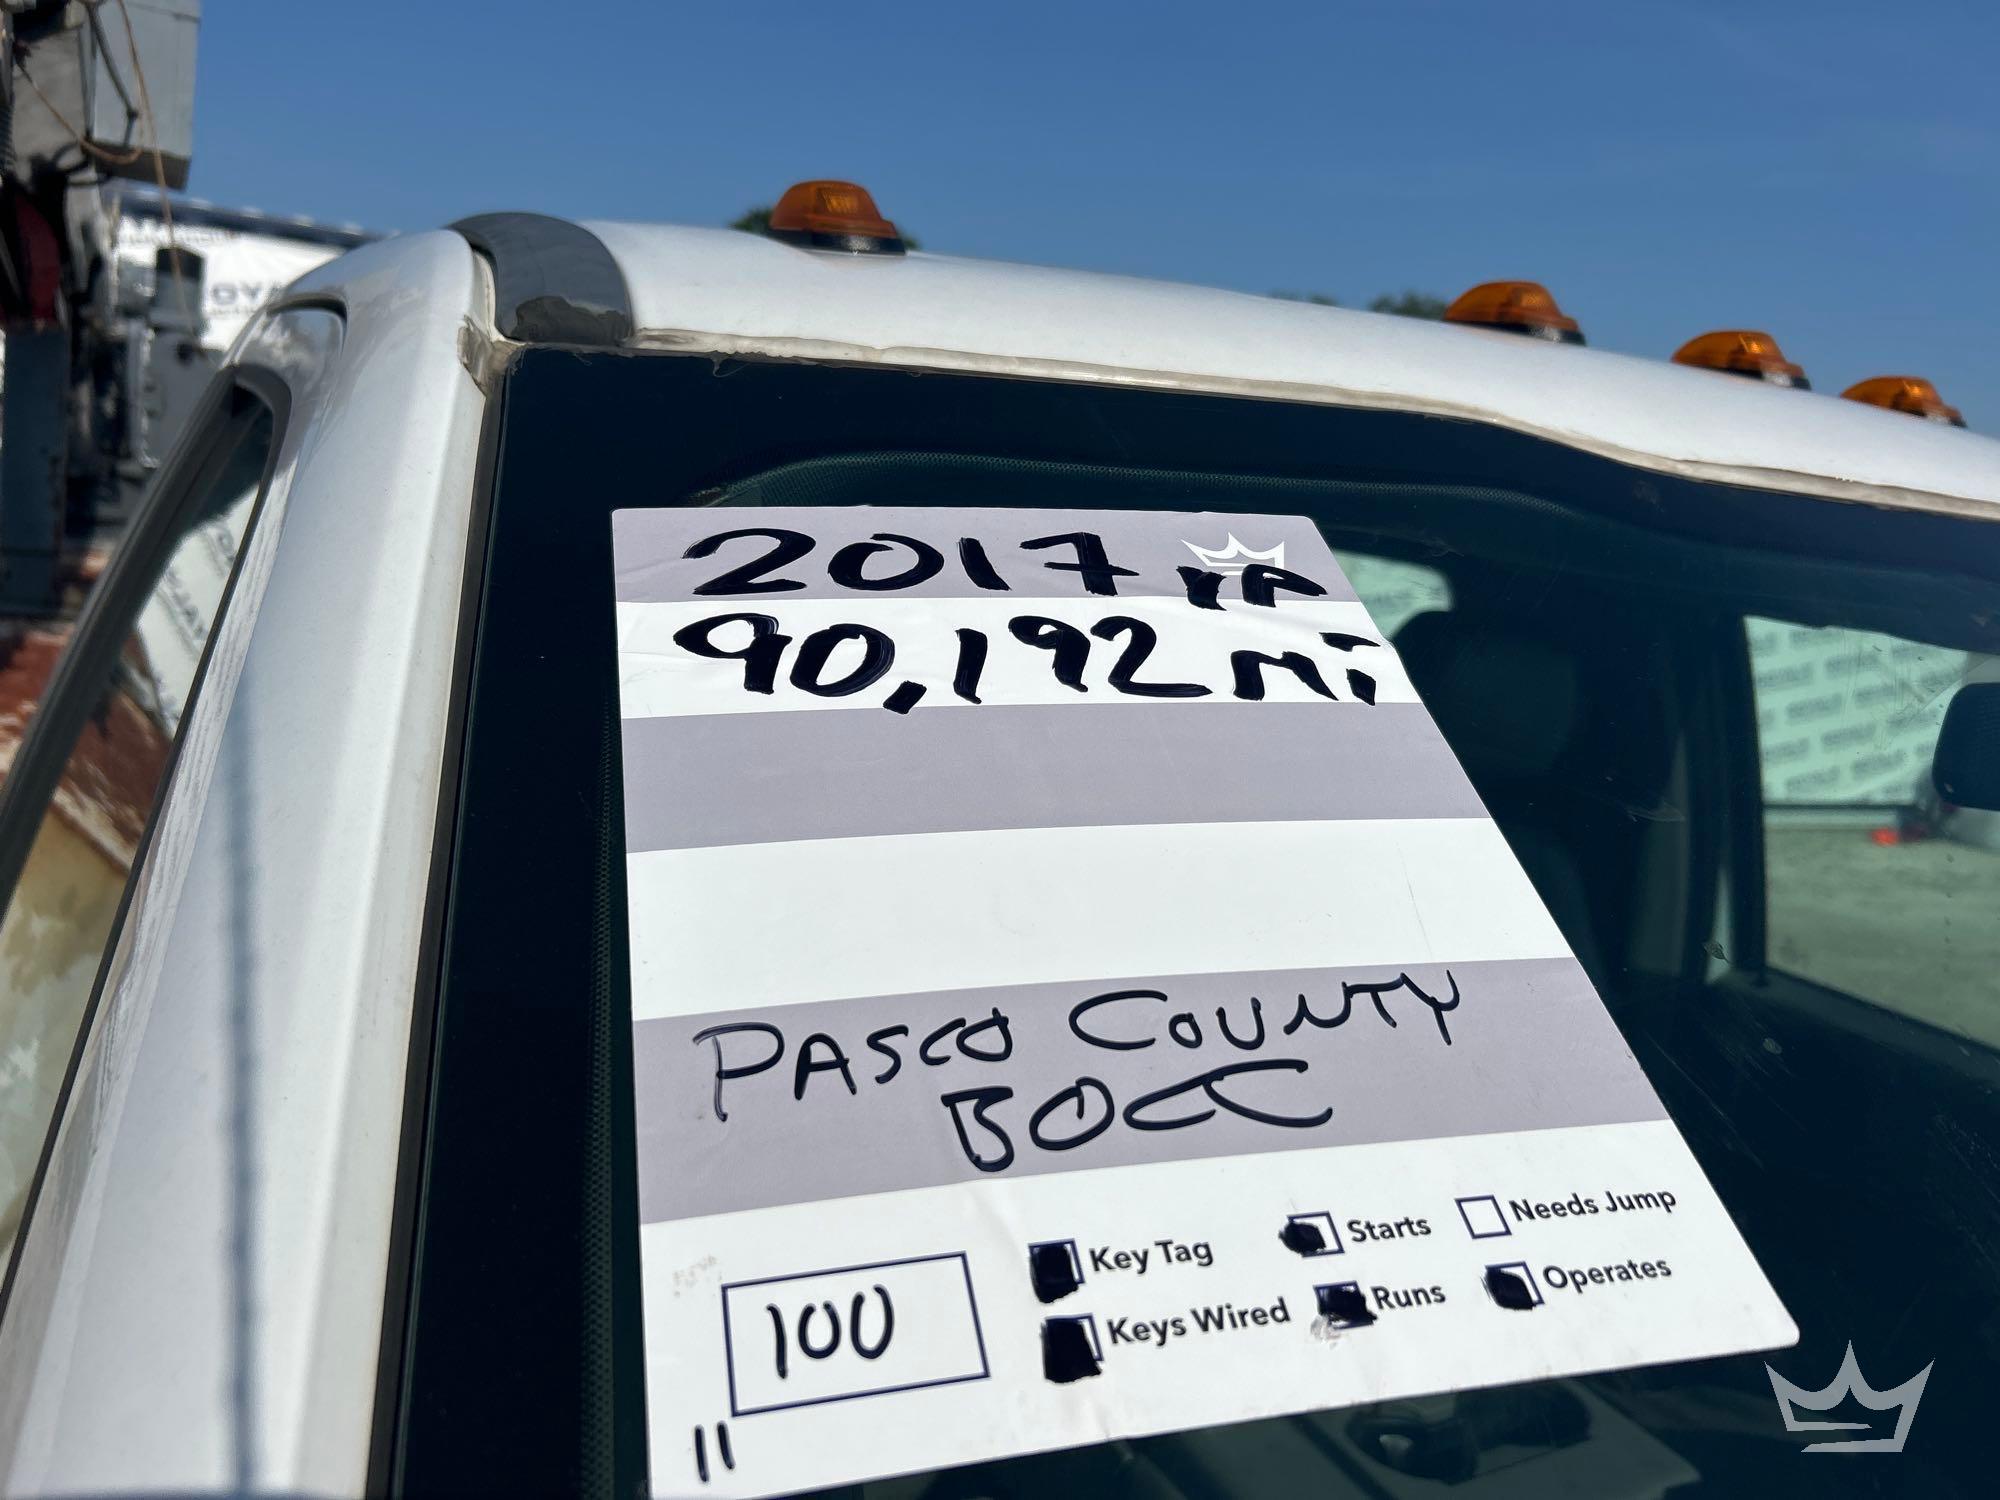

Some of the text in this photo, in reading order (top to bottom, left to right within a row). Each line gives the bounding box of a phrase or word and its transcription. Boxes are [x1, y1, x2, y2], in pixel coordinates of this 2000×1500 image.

[681, 527, 1139, 597] 2017
[672, 612, 1214, 715] 90,192
[692, 968, 1460, 1123] PASCO COUNTY
[940, 1058, 1335, 1174] BOCC
[1346, 1216, 1433, 1244] Starts
[1508, 1187, 1678, 1223] Needs Jump
[1089, 1239, 1215, 1276] Key Tag
[1542, 1257, 1673, 1295] Operates
[1106, 1297, 1293, 1348] Keys Wired
[1371, 1285, 1447, 1312] Runs
[765, 1283, 895, 1380] 100
